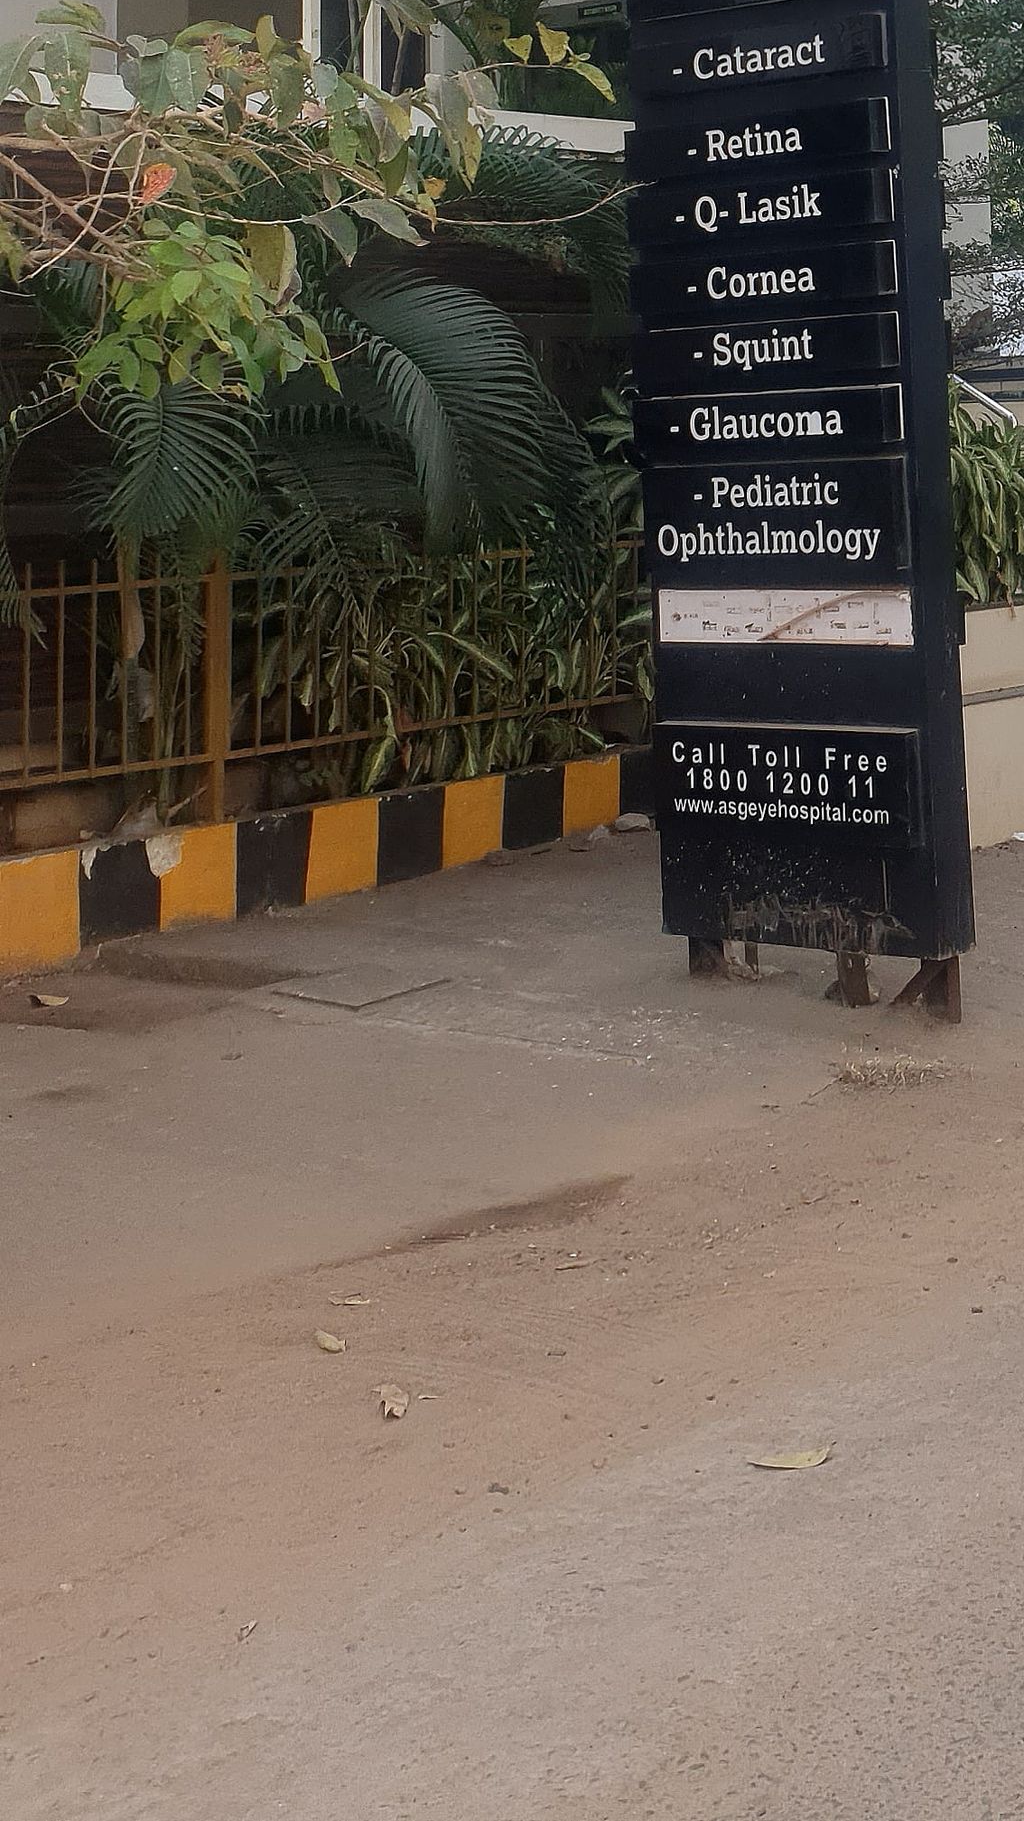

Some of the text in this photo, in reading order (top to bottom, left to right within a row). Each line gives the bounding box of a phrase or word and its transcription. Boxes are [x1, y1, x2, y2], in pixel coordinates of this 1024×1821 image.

[693, 34, 826, 80] Cataract
[705, 123, 803, 162] Retina
[737, 183, 822, 225] Lasik
[706, 266, 816, 300] Cornea
[713, 328, 814, 371] Squint
[689, 405, 844, 441] Glaucoma
[711, 472, 839, 508] Pediatric
[657, 519, 881, 563] Ophthalmology
[672, 741, 888, 772] Call Toll Free
[686, 767, 873, 799] 1800 1200 11
[674, 797, 890, 825] www.asgeyehospital.com
